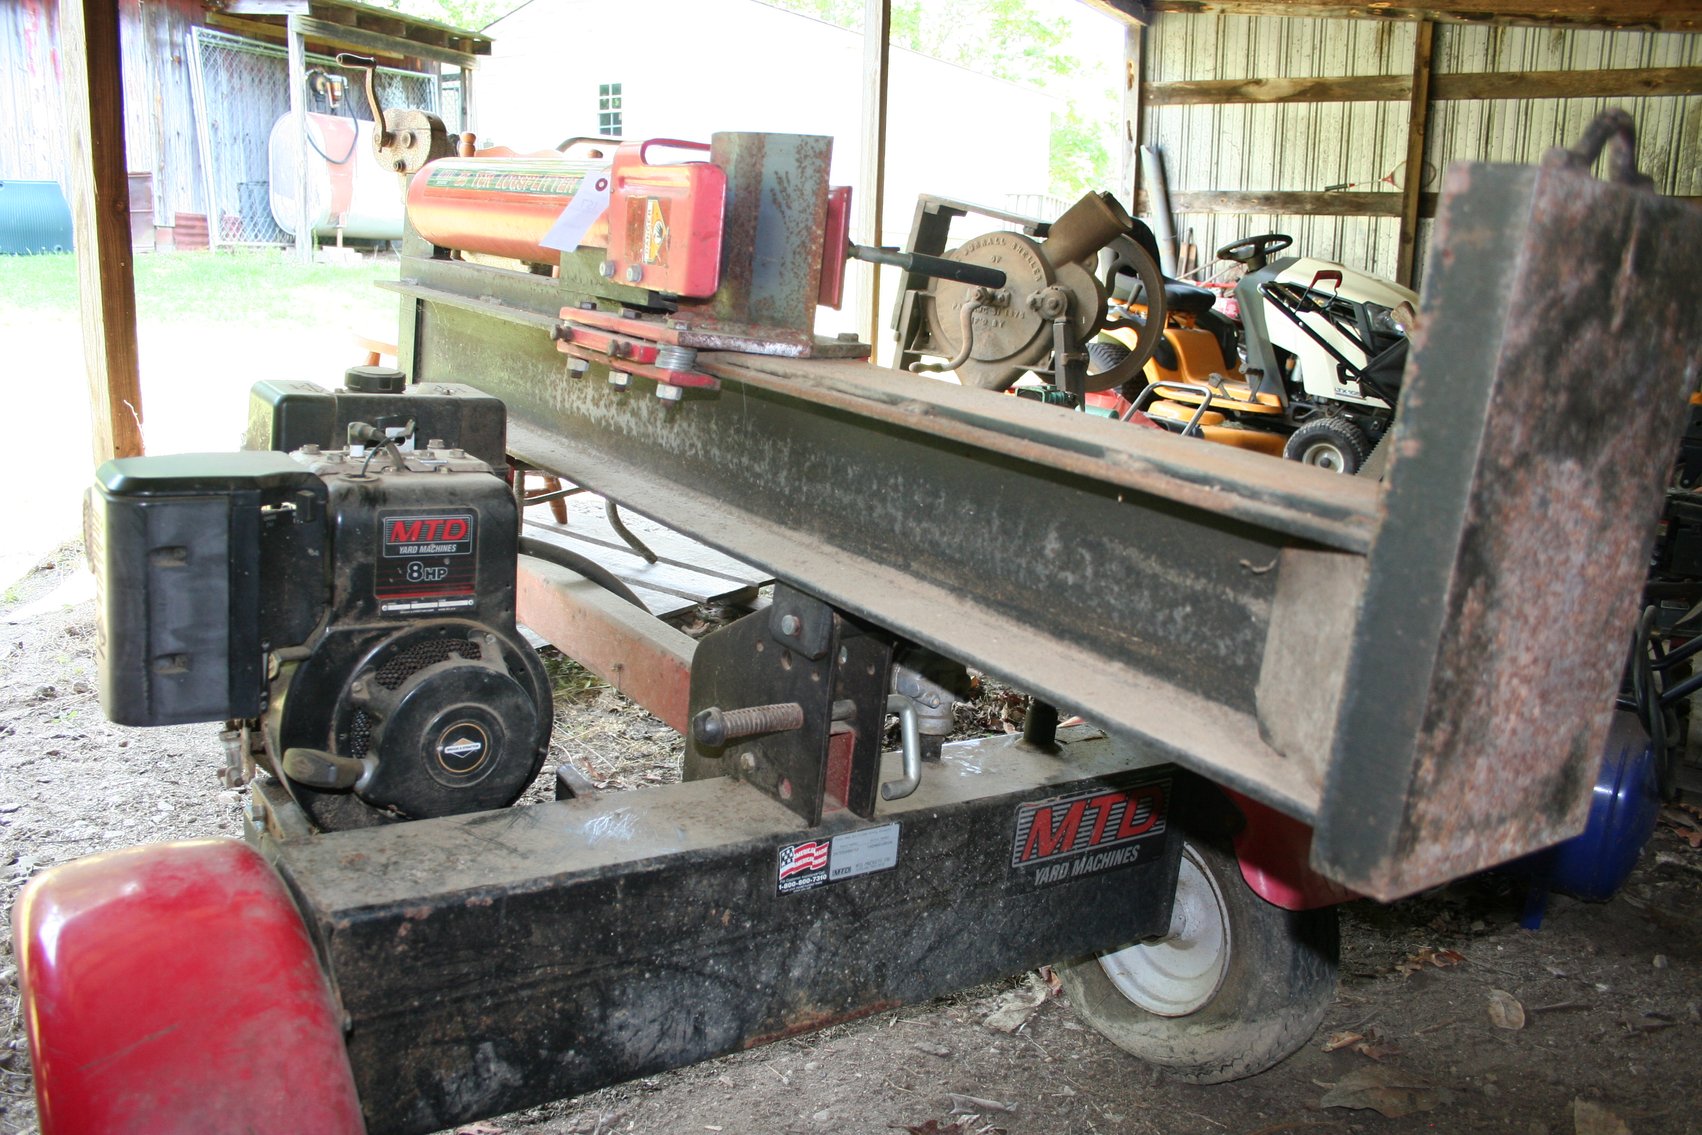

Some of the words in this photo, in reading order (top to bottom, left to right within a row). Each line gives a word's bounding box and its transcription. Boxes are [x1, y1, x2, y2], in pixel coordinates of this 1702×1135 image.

[390, 519, 468, 542] MTD
[399, 545, 418, 554] YARD
[419, 544, 457, 553] MACHINES
[1021, 787, 1163, 861] MTD
[1034, 864, 1068, 886] YARD
[1070, 845, 1141, 877] MACHINES
